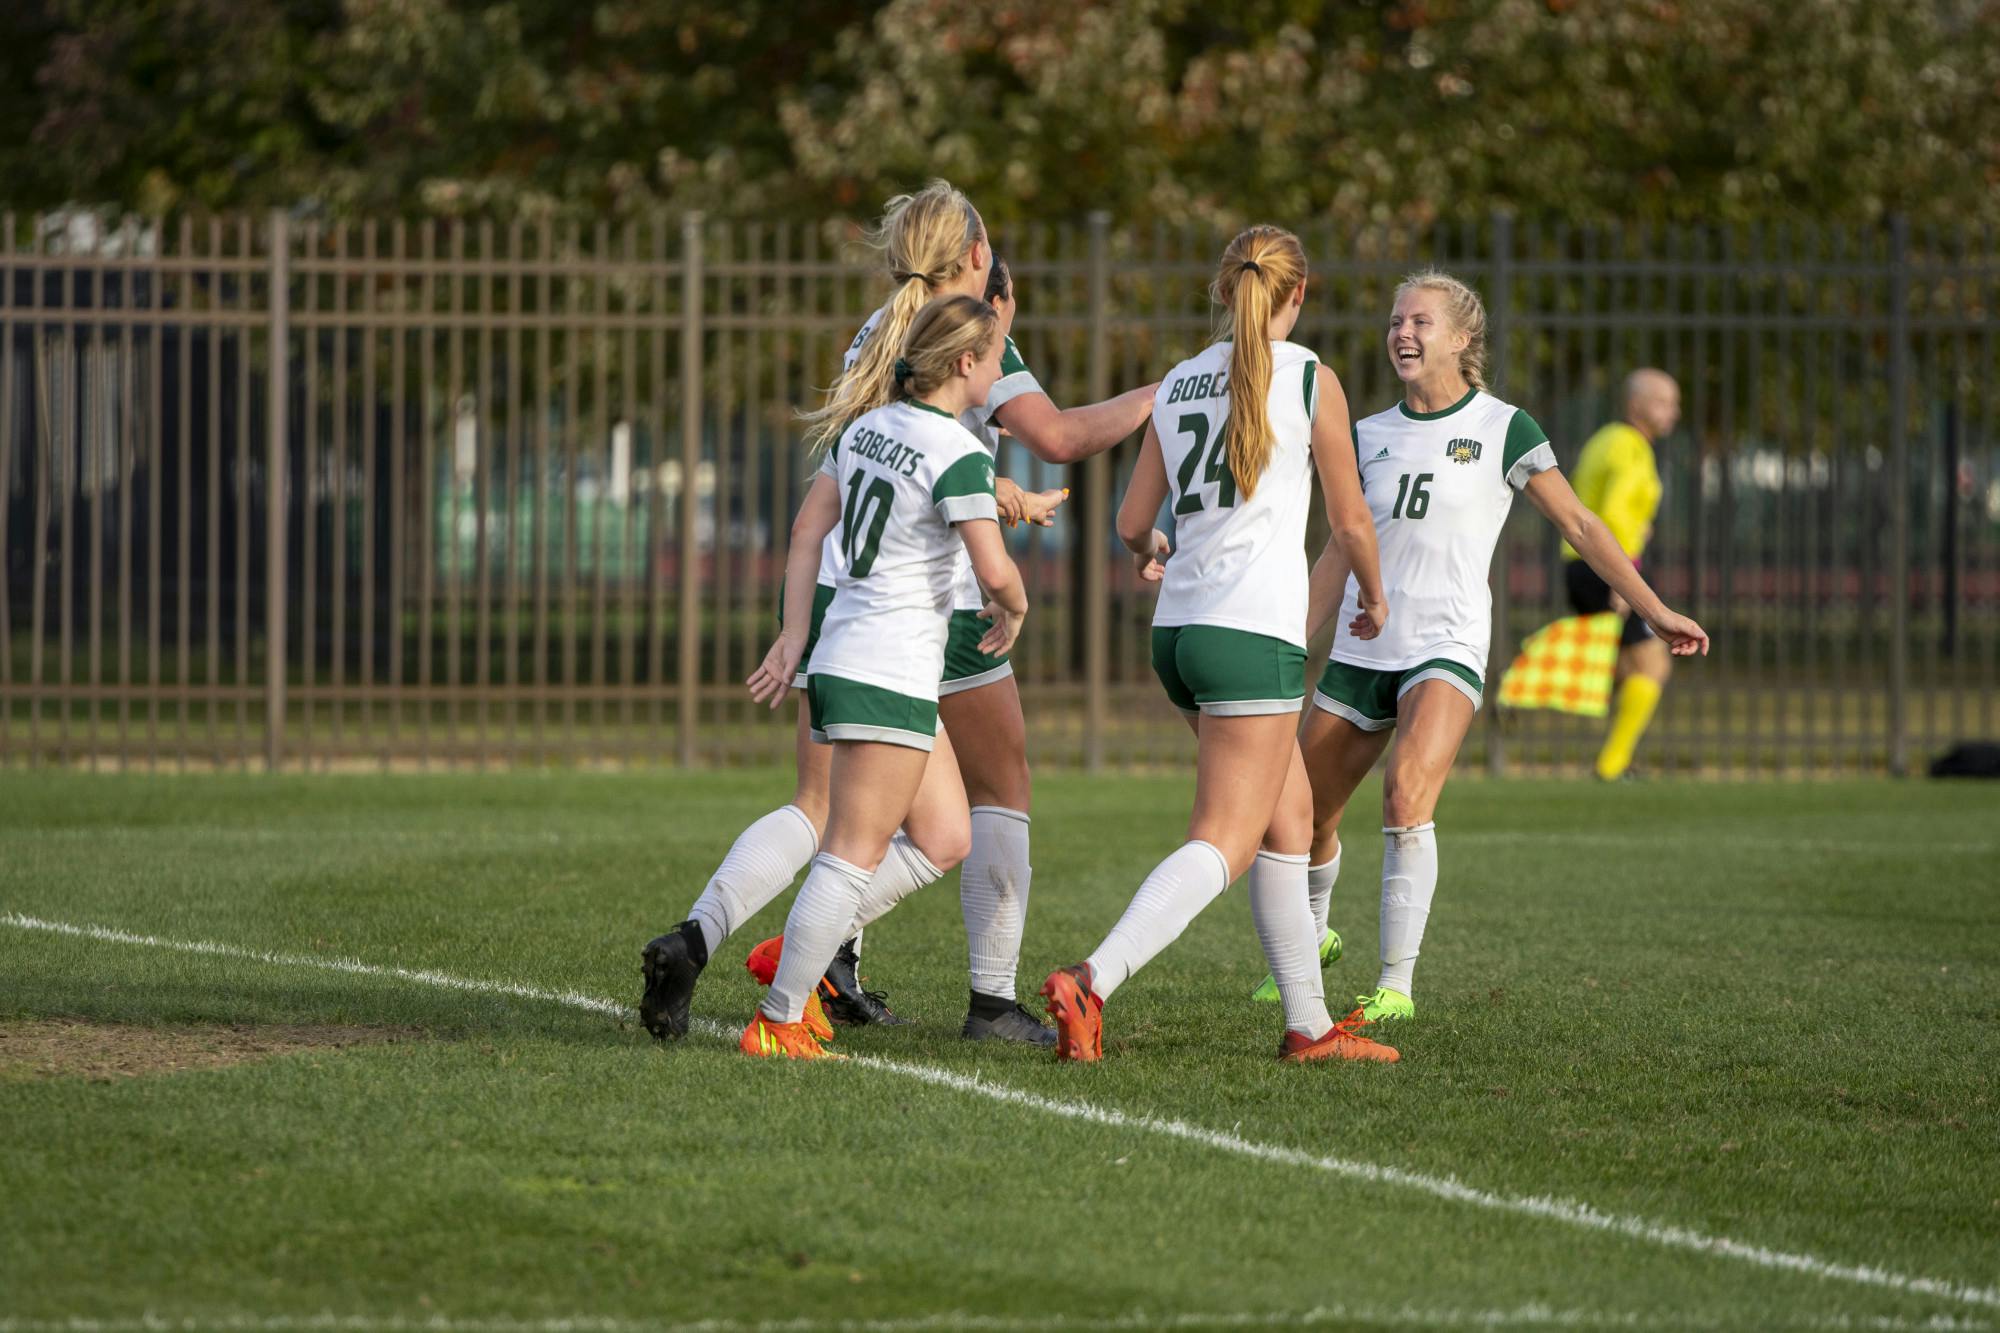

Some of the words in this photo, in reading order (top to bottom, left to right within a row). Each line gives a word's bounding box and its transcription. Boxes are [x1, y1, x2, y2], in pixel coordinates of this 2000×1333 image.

[1166, 371, 1231, 405] BOBC
[1175, 412, 1237, 515] 24
[1446, 438, 1483, 461] OHIO
[1391, 473, 1434, 520] 16
[841, 467, 895, 578] 10
